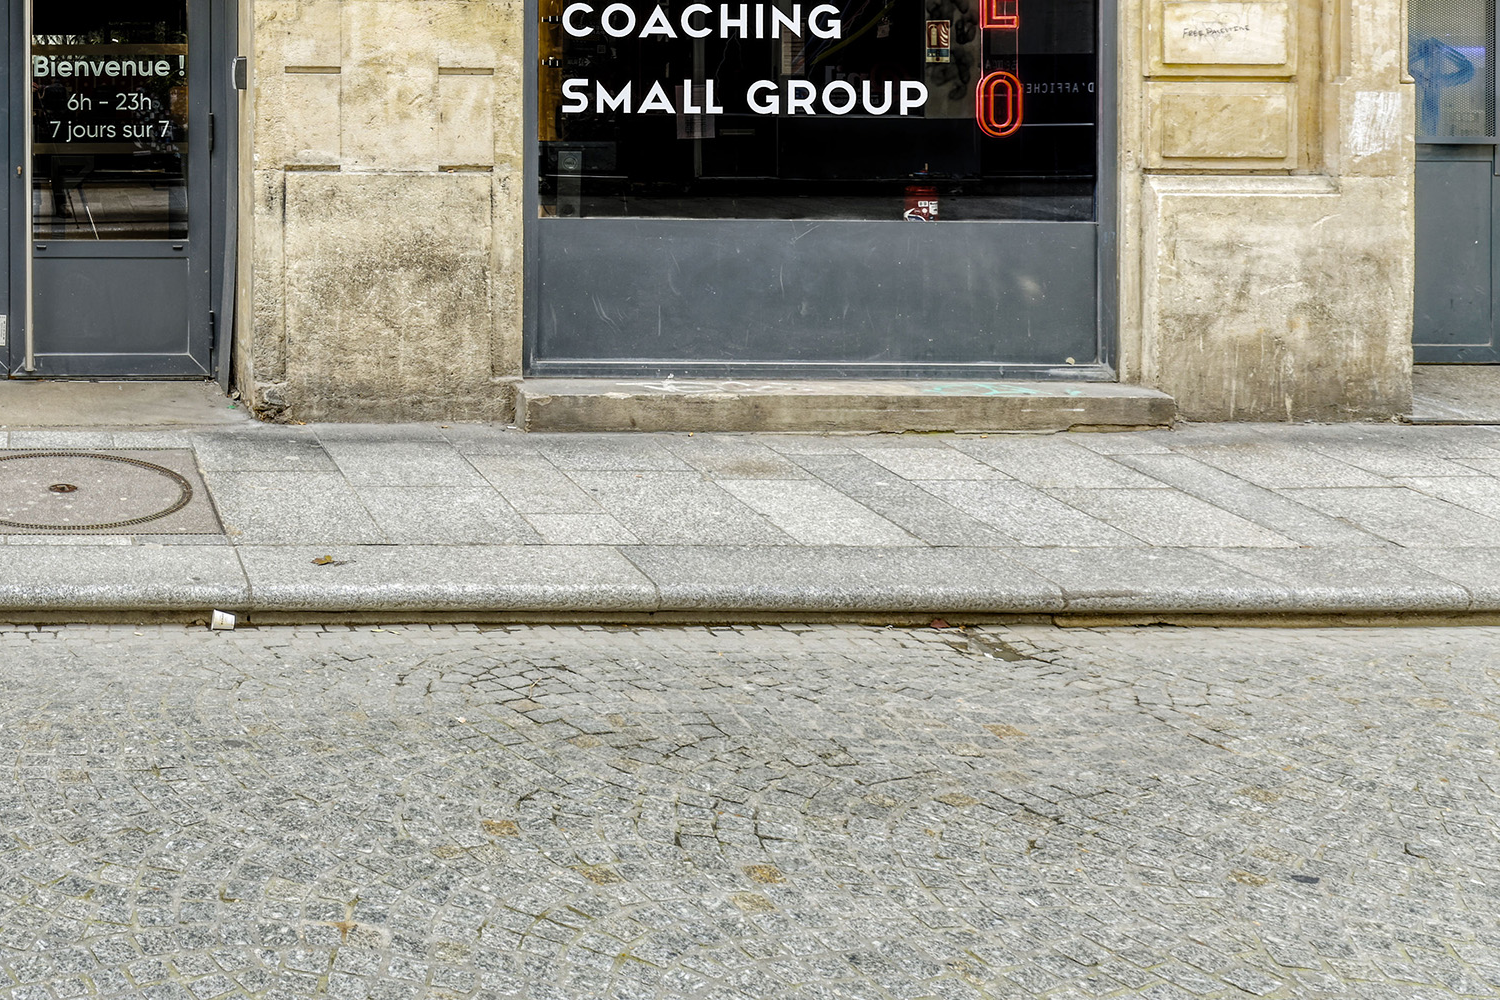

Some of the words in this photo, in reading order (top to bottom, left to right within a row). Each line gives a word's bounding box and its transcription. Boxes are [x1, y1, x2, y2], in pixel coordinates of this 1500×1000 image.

[562, 2, 842, 39] COACHING
[33, 55, 171, 77] Bienvenue
[67, 93, 92, 111] 6h
[116, 93, 152, 111] 23h
[562, 78, 724, 114] SMALL
[746, 79, 929, 116] GROUP
[50, 120, 62, 138] 7
[66, 120, 117, 142] jours
[122, 124, 153, 138] sur
[158, 120, 170, 138] 7
